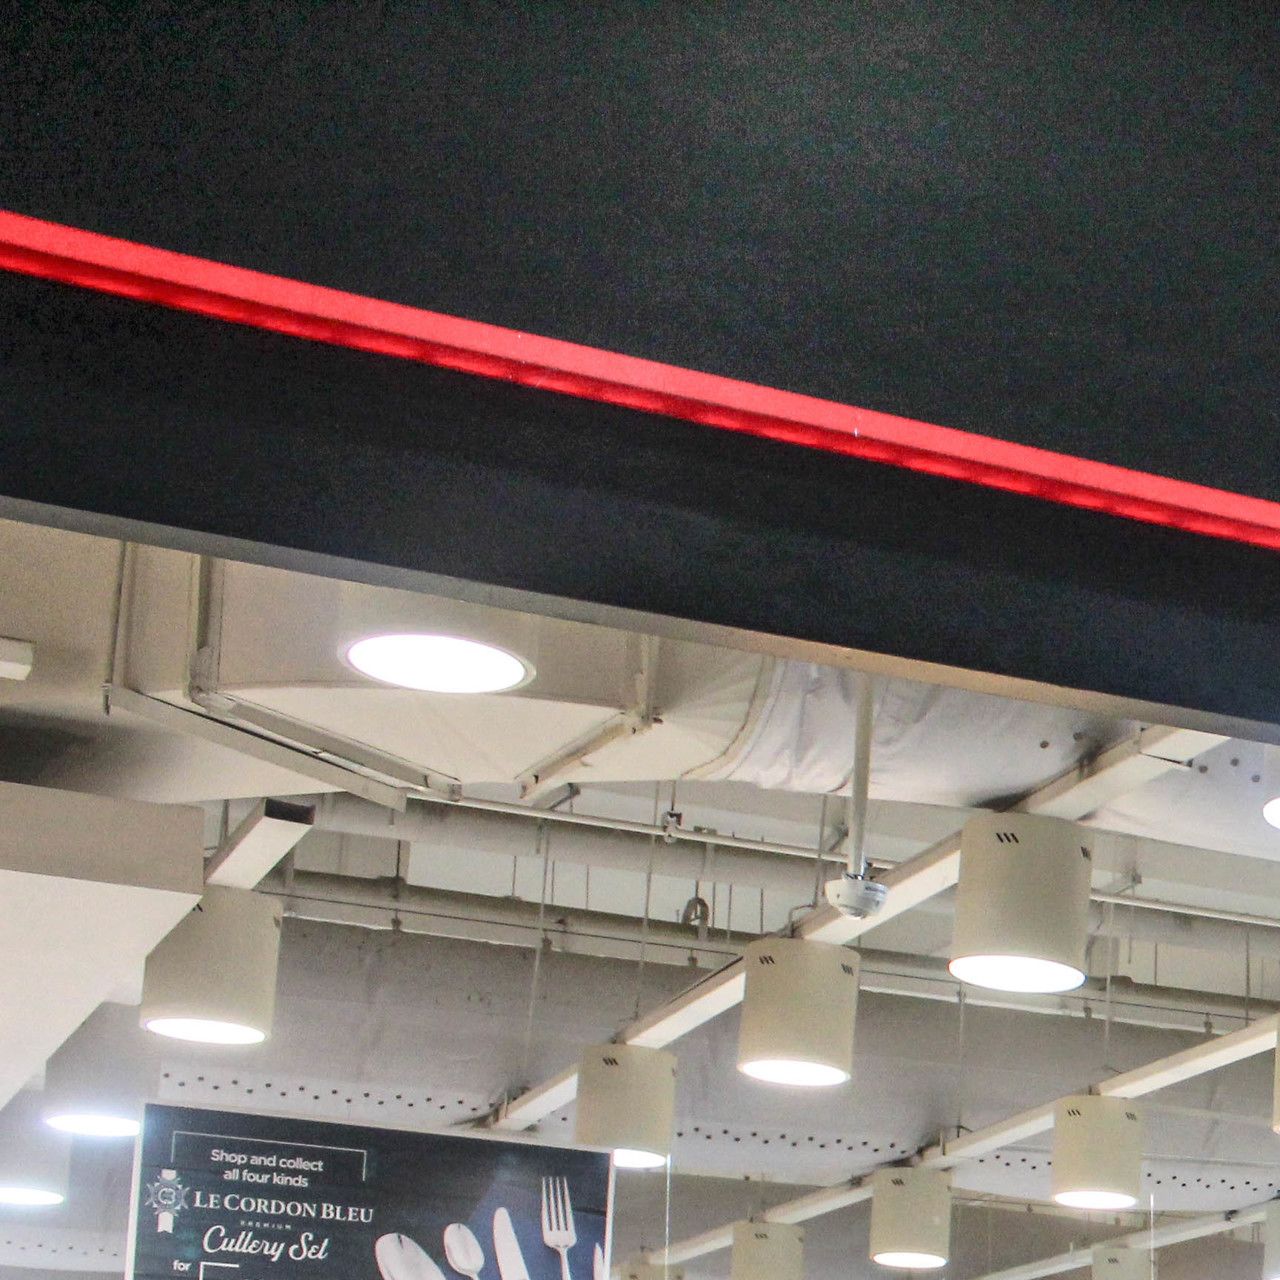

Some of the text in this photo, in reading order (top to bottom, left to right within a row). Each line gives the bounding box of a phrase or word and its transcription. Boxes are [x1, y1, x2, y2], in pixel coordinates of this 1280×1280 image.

[210, 1149, 324, 1172] Shop and collect
[223, 1168, 309, 1188] all four kinds
[194, 1191, 374, 1223] LE CORDON BLEU
[288, 1231, 330, 1261] Set
[173, 1259, 192, 1273] for
